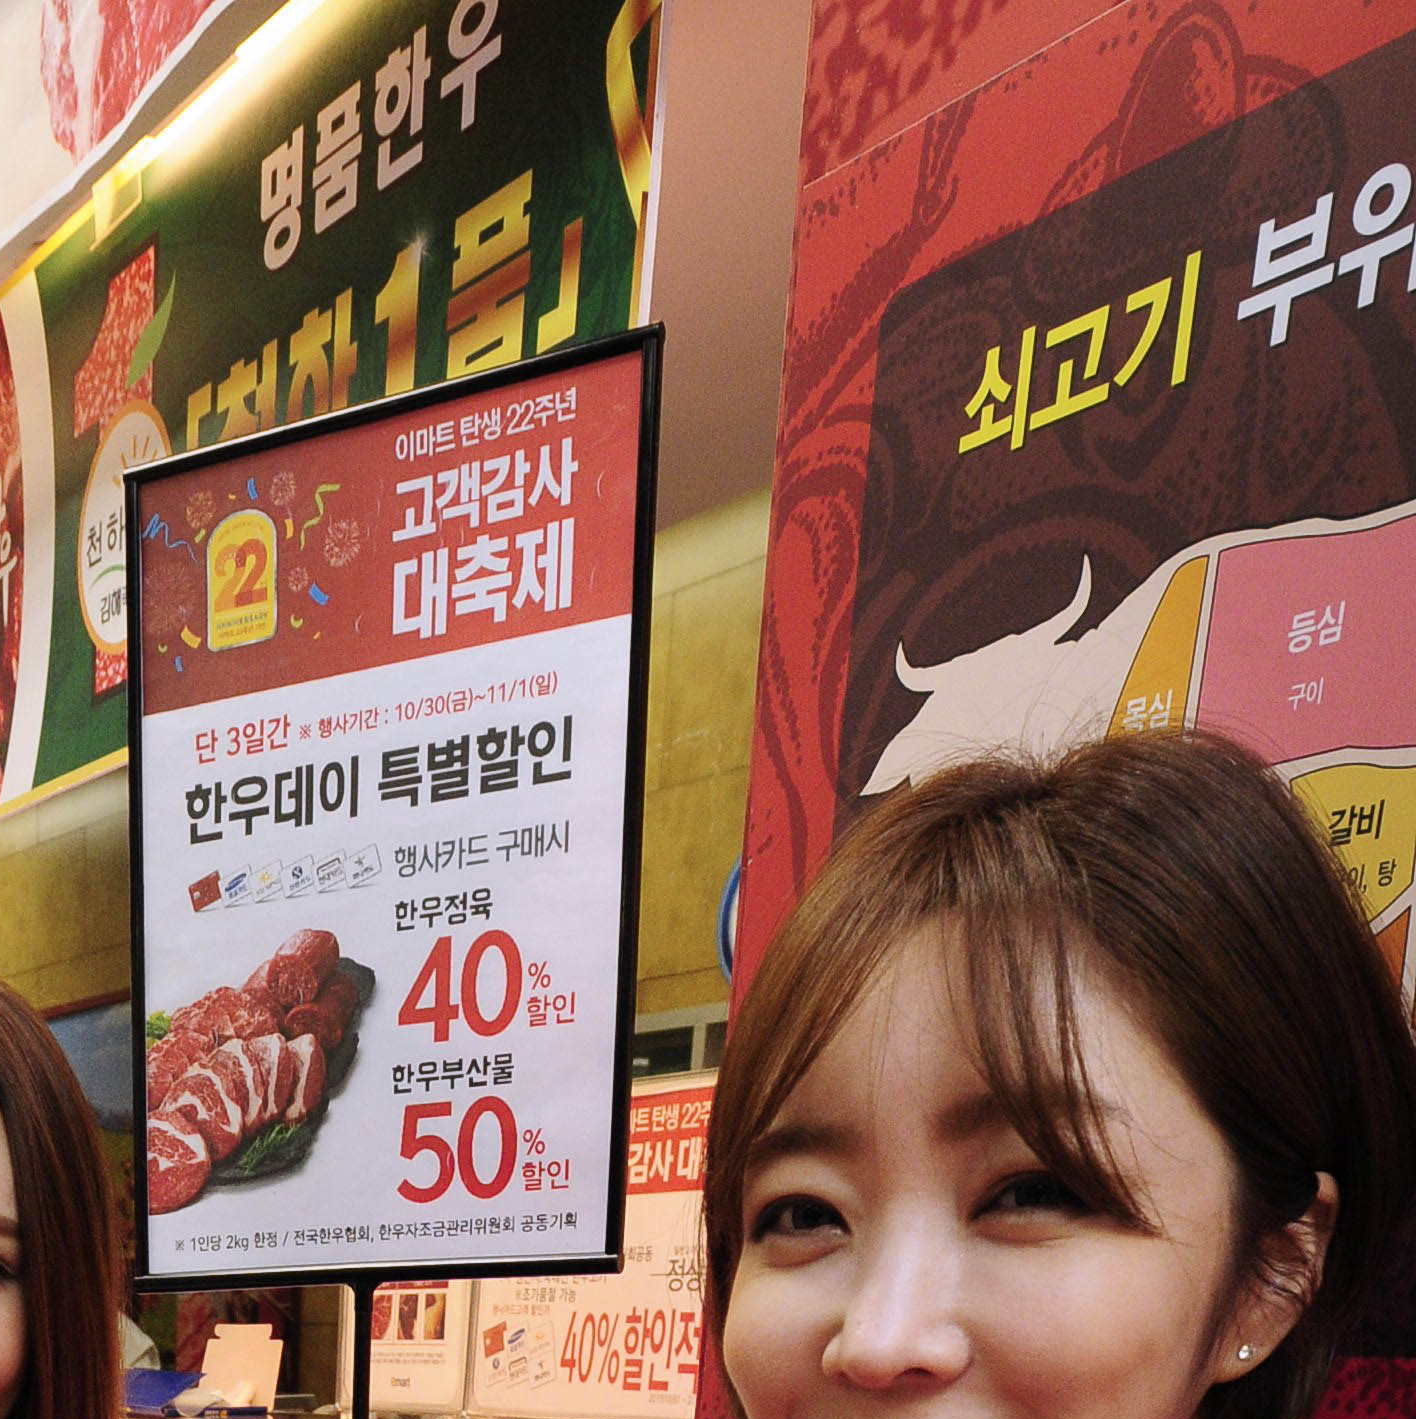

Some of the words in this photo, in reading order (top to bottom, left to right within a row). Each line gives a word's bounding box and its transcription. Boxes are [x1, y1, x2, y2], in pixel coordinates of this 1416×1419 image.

[260, 0, 502, 271] 명품한우
[959, 249, 1202, 455] 쇠고기
[396, 421, 456, 462] 이마트
[460, 409, 503, 447] 탄생
[507, 387, 577, 435] 22주년
[393, 437, 580, 543] 고객감사
[215, 539, 268, 612] 22
[392, 517, 577, 640] 대축제
[1288, 600, 1346, 654] 등심
[194, 732, 220, 765] 단
[225, 715, 291, 758] 3일간
[317, 707, 380, 738] 행사기간
[395, 672, 560, 723] 10/30(금)~11/1(일)
[1123, 688, 1174, 732] 목심
[1288, 677, 1325, 711] 구이
[185, 752, 361, 846] 한우데이
[377, 715, 574, 810] 특별할인
[1329, 798, 1386, 848] 갈비
[394, 832, 490, 879] 행사카드
[496, 820, 571, 863] 구매시
[1378, 858, 1398, 888] 탕
[393, 887, 493, 933] 한우정육
[527, 991, 578, 1027] 할인
[391, 1052, 516, 1095] 한우부산물
[652, 1103, 680, 1132] 탄생
[521, 1159, 572, 1192] 할인
[628, 1139, 674, 1184] 감사
[190, 1235, 222, 1252] 1인당
[226, 1234, 249, 1252] 2kg
[254, 1231, 278, 1249] 한정
[378, 1216, 516, 1241] 한우자조금관리위원회
[520, 1211, 579, 1233] 공동기획
